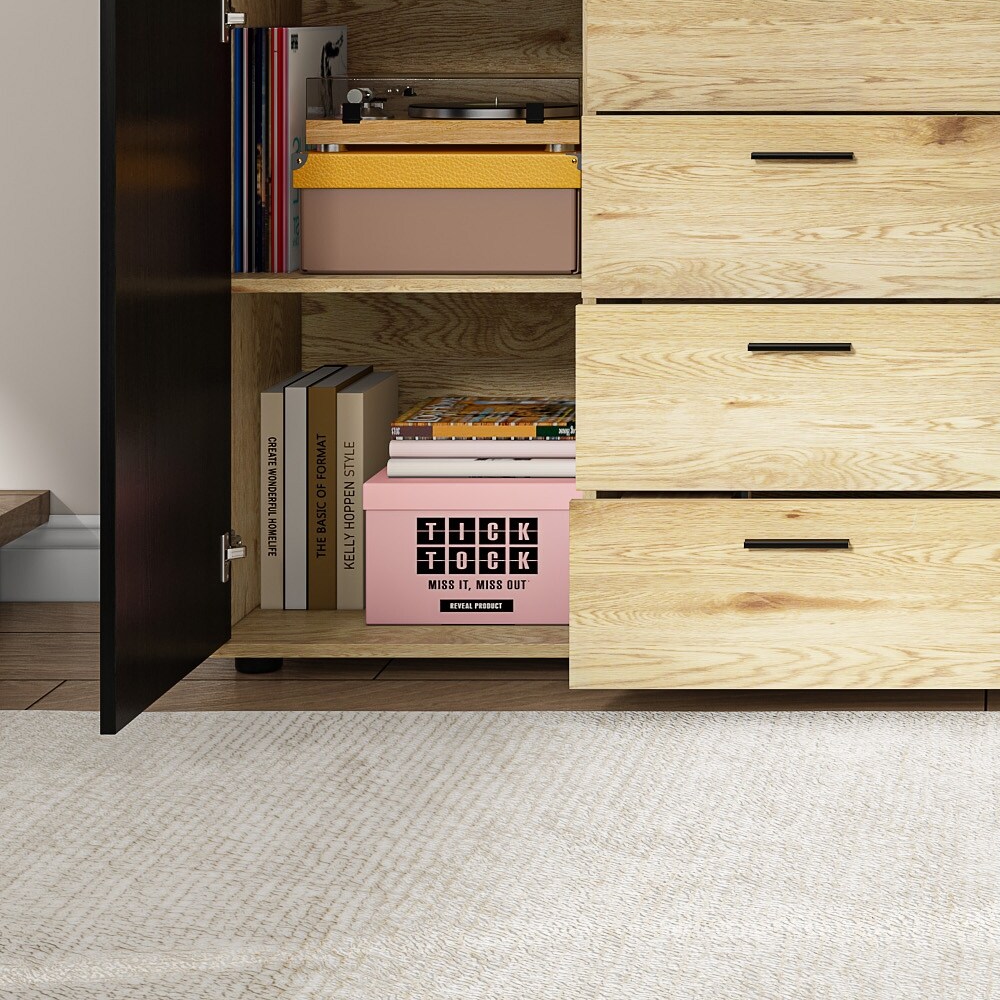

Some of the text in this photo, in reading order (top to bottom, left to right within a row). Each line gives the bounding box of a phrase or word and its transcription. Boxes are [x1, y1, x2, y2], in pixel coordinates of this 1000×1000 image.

[267, 436, 278, 557] CREATE WONDERFUL HOMELIFE
[315, 433, 328, 559] THE BASIC OF FORMAT
[343, 441, 356, 570] KELLY HOPPEN STYLE
[425, 522, 530, 541] TICK
[425, 551, 530, 570] TOCK
[428, 579, 527, 592] MISS IT, MISS OUT
[449, 602, 503, 610] REVEAL PRODUCT
